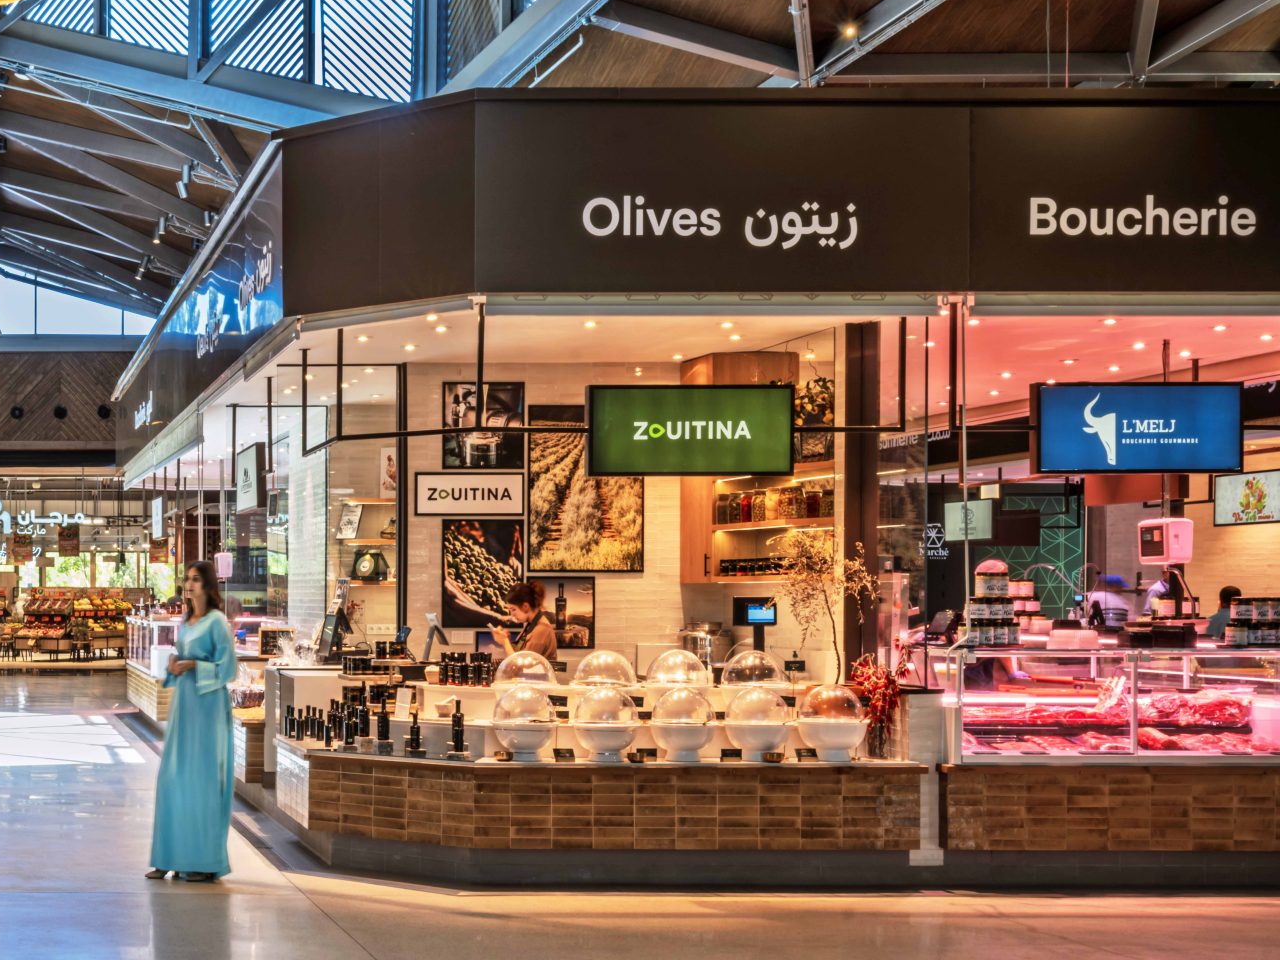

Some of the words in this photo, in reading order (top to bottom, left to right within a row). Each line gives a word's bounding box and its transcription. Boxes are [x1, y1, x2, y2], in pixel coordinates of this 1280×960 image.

[582, 195, 722, 237] Olives
[744, 201, 858, 249] زيتون
[1029, 194, 1257, 236] Boucherie
[634, 420, 752, 441] ZOUITINA
[1122, 419, 1176, 433] L'MELJ
[427, 487, 512, 501] ZOUITINA
[17, 509, 85, 527] مرجان
